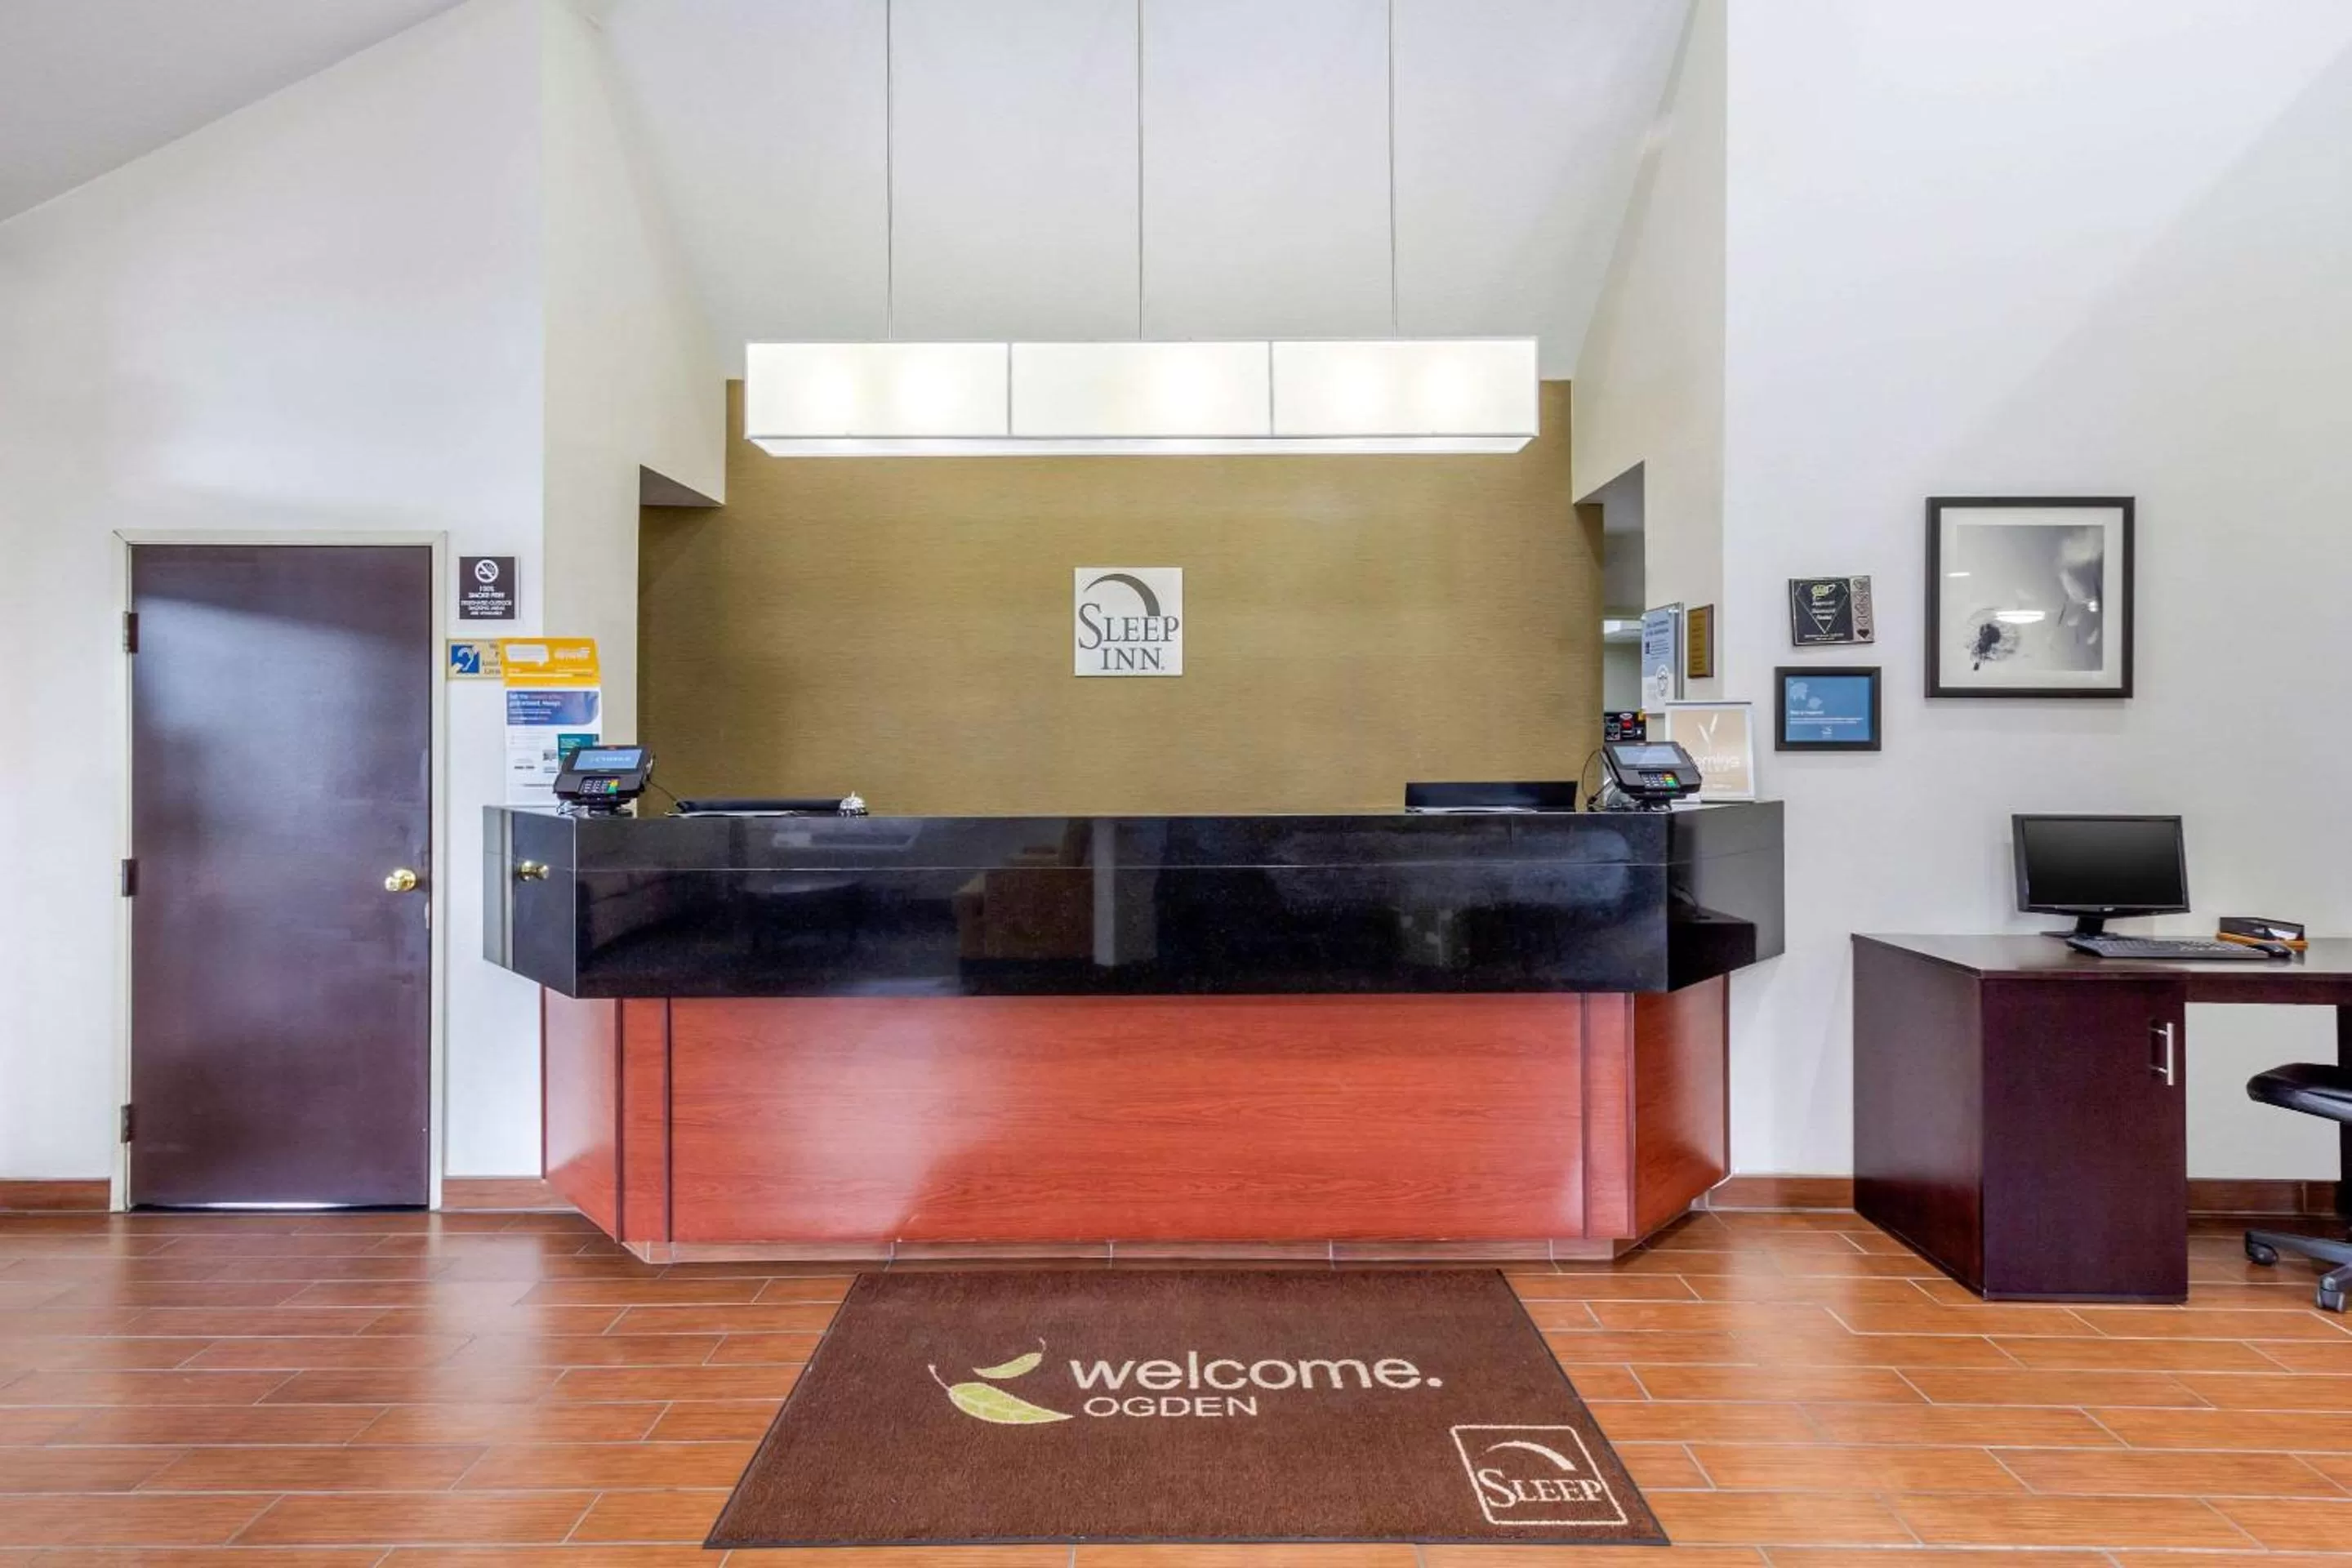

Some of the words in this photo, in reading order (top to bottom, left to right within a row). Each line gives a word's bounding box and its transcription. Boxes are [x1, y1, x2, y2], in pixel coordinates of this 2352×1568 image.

[1077, 602, 1180, 650] SLEEP
[1100, 647, 1162, 670] INN
[1069, 1351, 1444, 1390] welcome.
[1083, 1396, 1258, 1418] OGDEN
[1477, 1468, 1603, 1508] SLEEP
